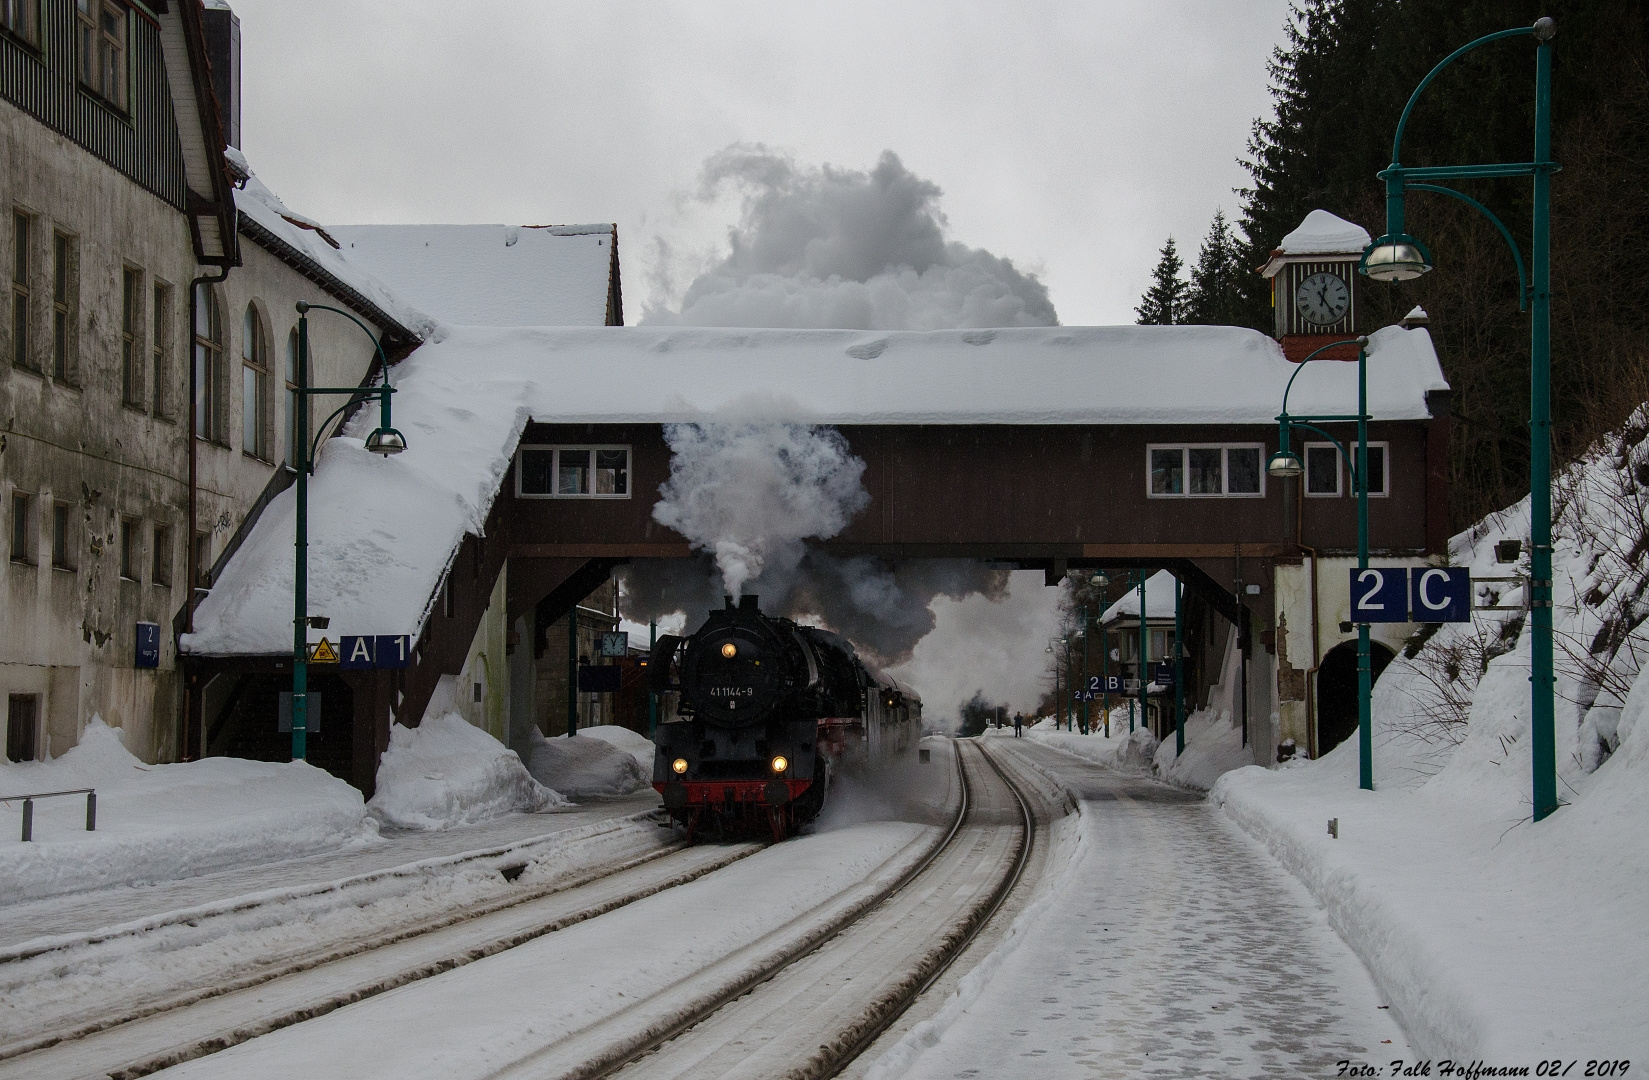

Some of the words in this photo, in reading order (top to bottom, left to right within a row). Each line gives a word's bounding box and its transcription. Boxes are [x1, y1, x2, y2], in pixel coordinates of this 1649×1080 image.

[1357, 569, 1385, 610] 2
[1419, 568, 1452, 611] C
[148, 626, 153, 643] 2
[349, 636, 371, 662] A
[394, 635, 405, 661] 1
[1090, 676, 1099, 690] 2
[1108, 676, 1118, 690] B
[1074, 690, 1081, 699] 2
[1085, 690, 1092, 699] A
